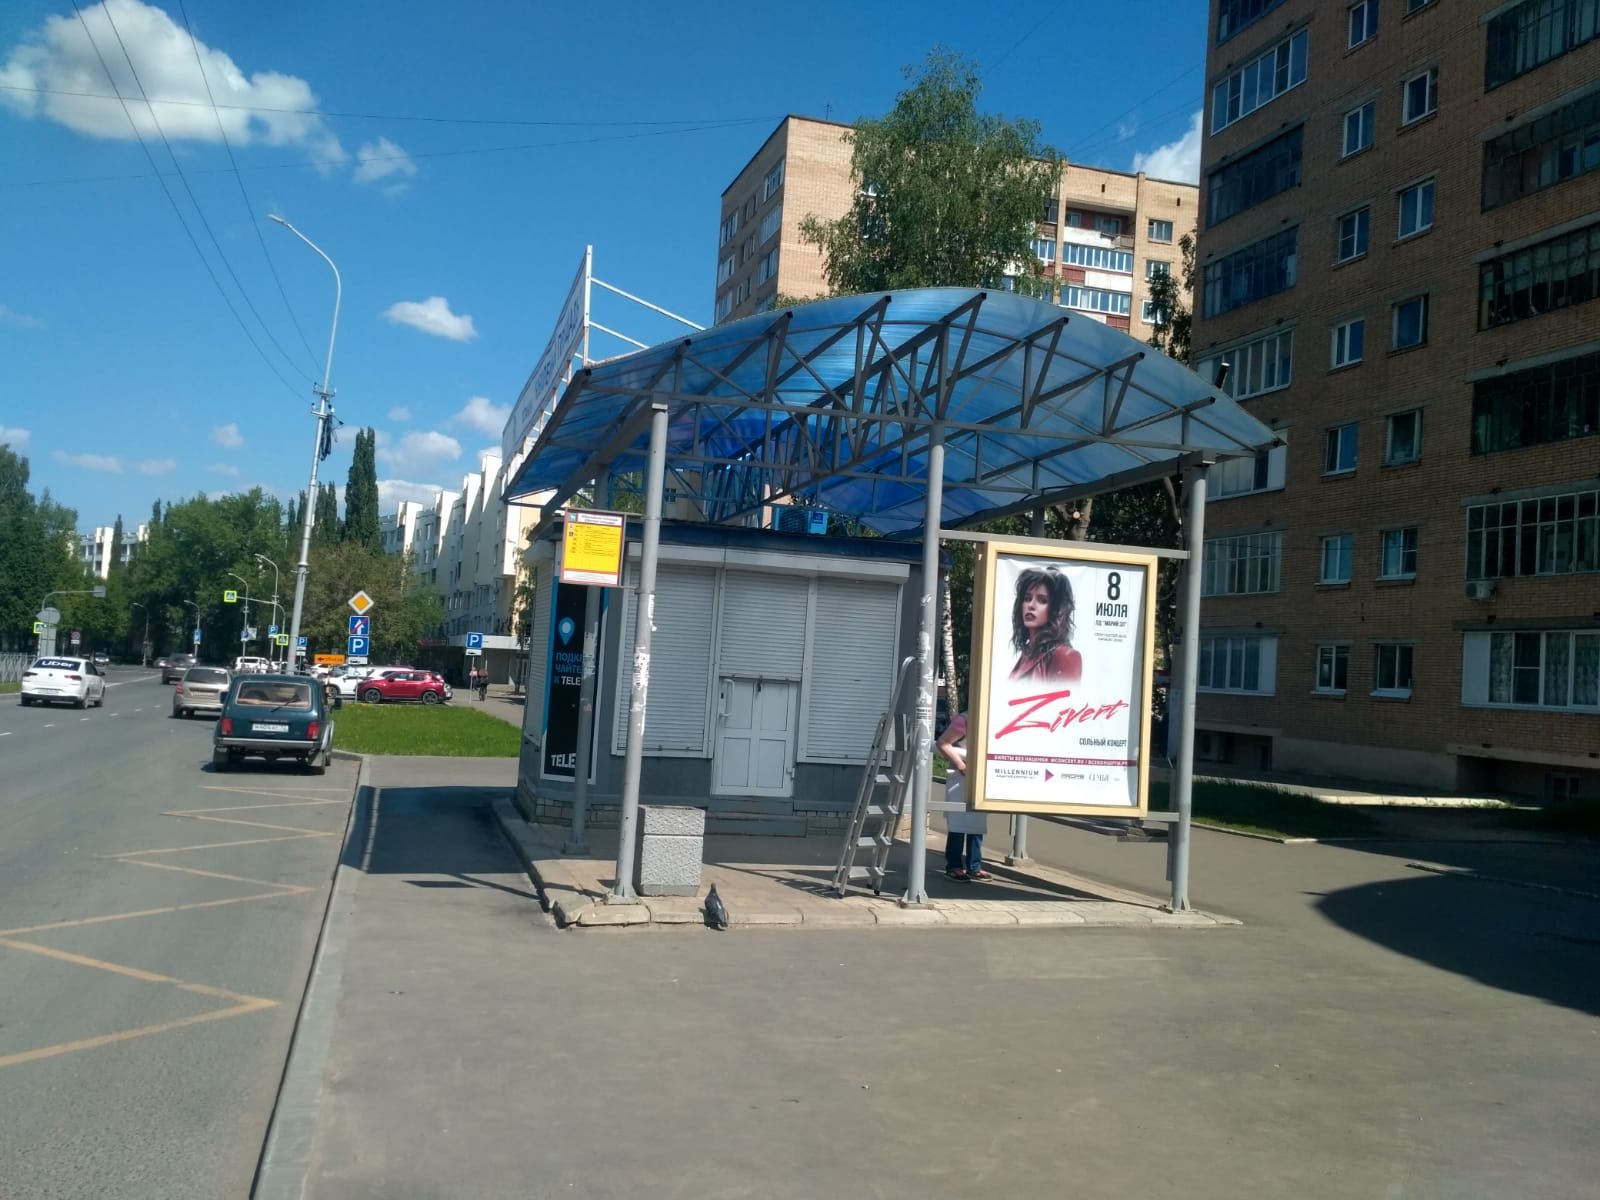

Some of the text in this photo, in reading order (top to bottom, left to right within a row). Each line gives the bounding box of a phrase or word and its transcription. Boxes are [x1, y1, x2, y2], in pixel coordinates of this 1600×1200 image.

[1107, 572, 1121, 601] 8
[1095, 602, 1128, 618] ИЮЛЯ
[352, 639, 364, 653] P
[469, 634, 480, 646] P
[41, 660, 74, 668] Uber
[555, 663, 582, 673] ЧАЙТЕ
[561, 676, 582, 686] TELE
[994, 689, 1129, 740] Zivert
[1079, 737, 1127, 747] СОЛЬНЫЙ КОНЦЕРТ
[551, 753, 577, 768] TELE
[995, 768, 1039, 776] MILLENNIUM
